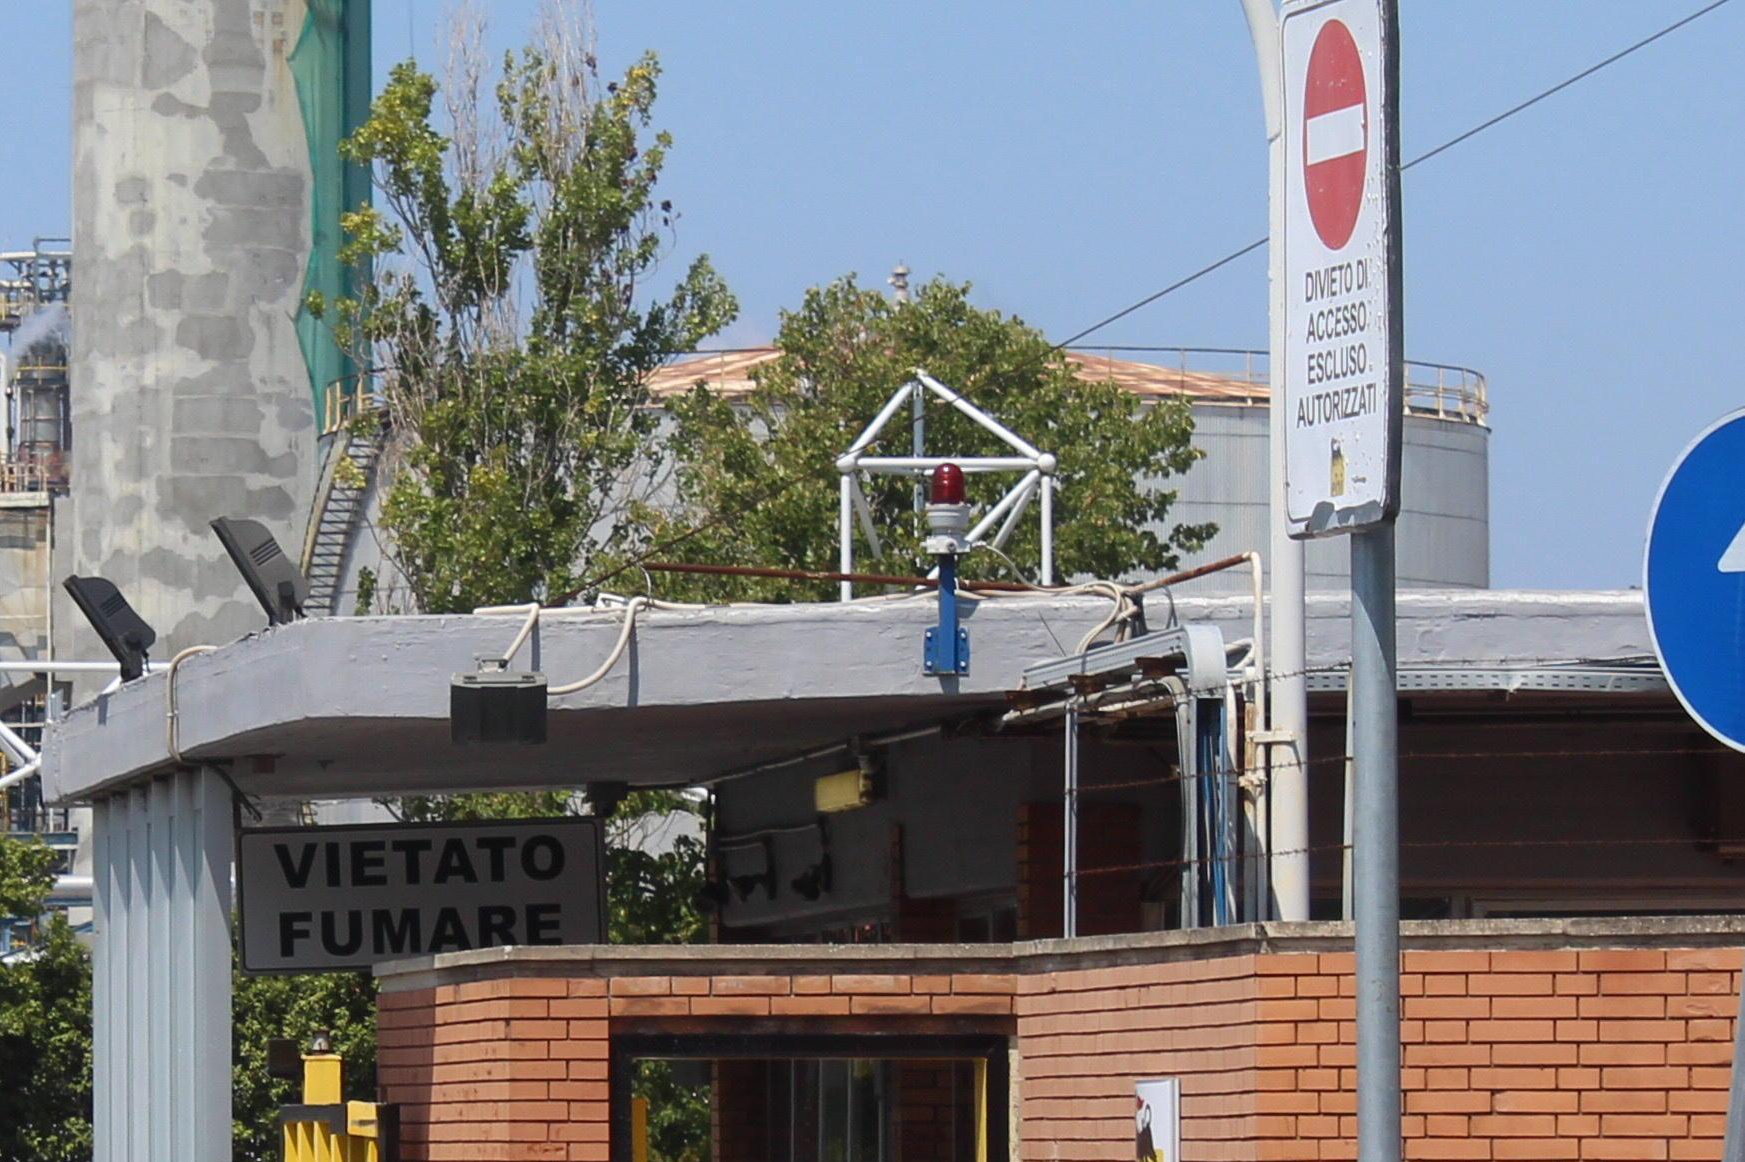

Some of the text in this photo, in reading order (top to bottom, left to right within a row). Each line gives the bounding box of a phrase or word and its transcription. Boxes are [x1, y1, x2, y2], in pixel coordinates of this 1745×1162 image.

[1305, 258, 1368, 303] DIVIETO DI
[1306, 300, 1367, 344] ACCESSO
[1307, 342, 1367, 385] ESCLUSO
[1296, 383, 1377, 429] AUTORIZZATI
[273, 834, 566, 889] VIETATO
[278, 903, 563, 958] FUMARE
